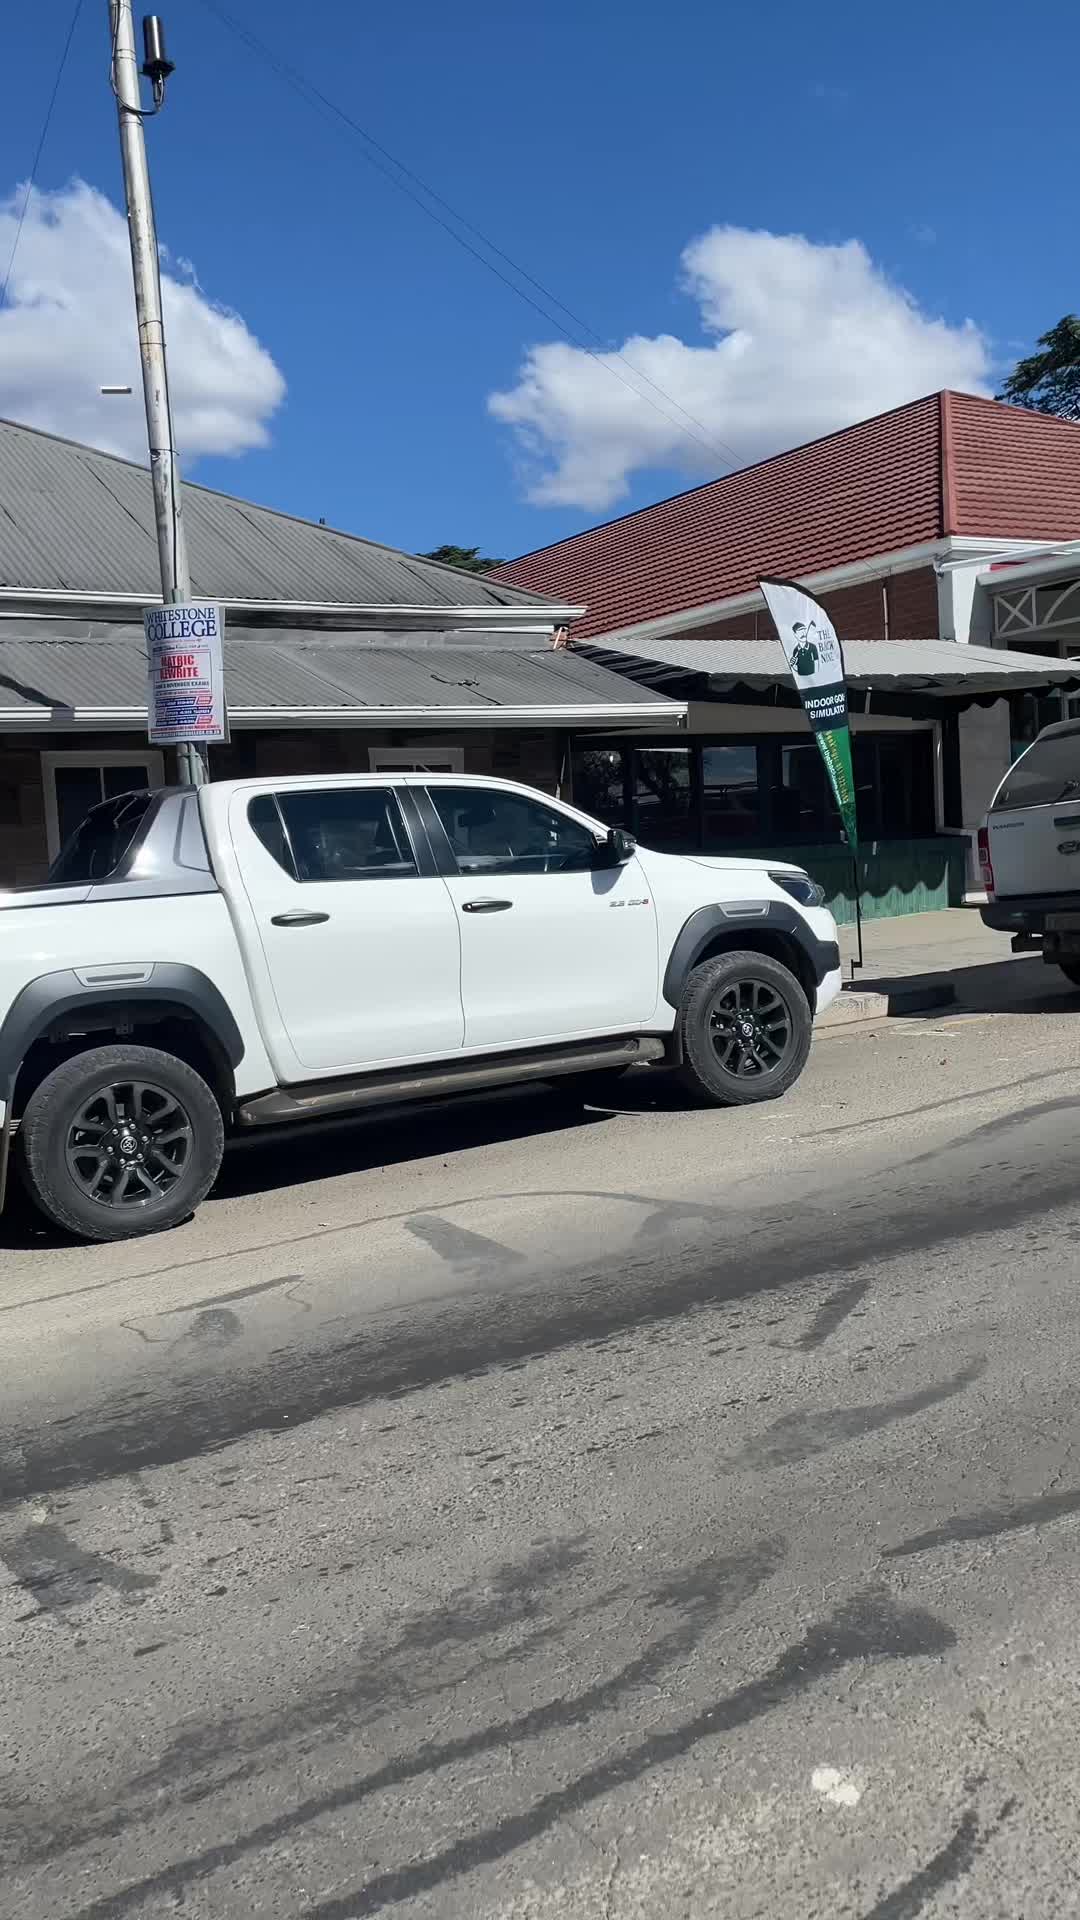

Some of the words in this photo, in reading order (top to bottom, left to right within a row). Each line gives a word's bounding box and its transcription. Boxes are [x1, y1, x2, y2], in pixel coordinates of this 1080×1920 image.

[146, 607, 215, 624] WHITESTONE
[147, 620, 217, 641] COLLEGE
[816, 629, 832, 640] THE
[160, 654, 194, 667] MATRIC
[160, 667, 199, 680] REWRITE
[804, 695, 834, 709] INDOOR
[810, 703, 845, 719] SIMULATO
